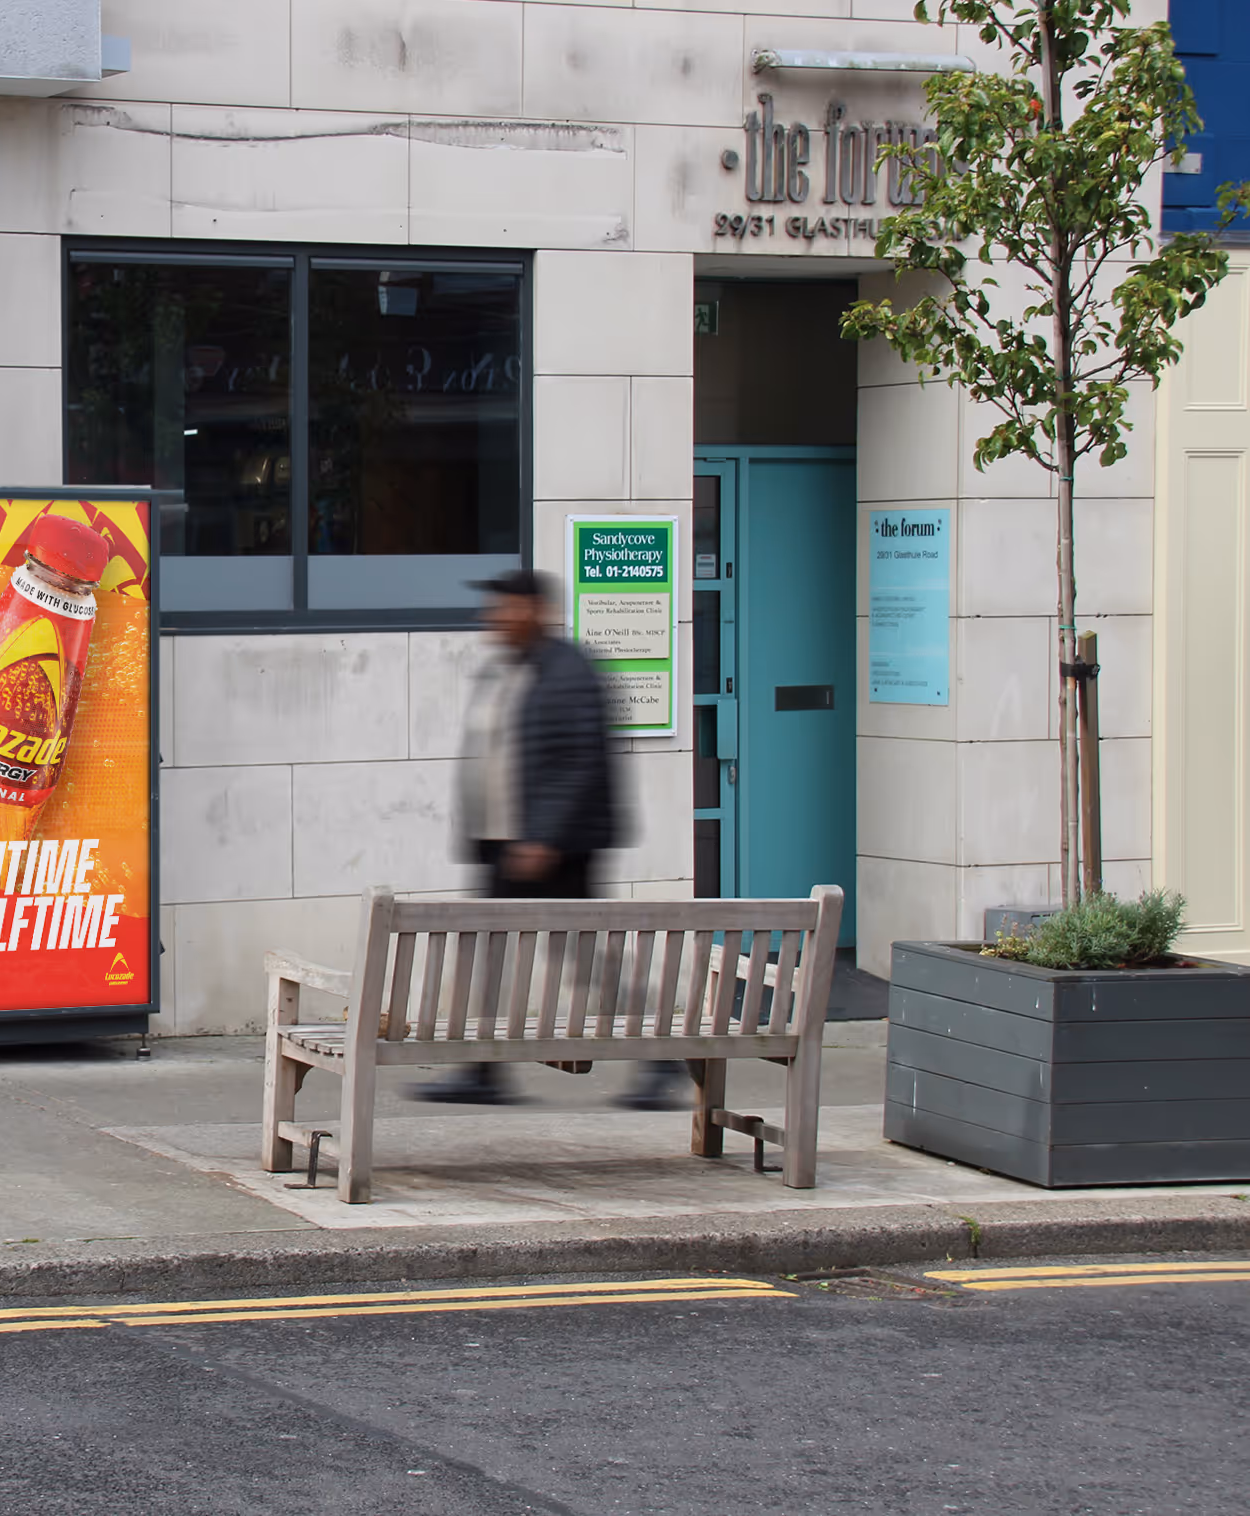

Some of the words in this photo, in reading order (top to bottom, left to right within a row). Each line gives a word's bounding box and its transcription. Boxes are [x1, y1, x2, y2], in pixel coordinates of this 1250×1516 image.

[743, 93, 811, 203] the
[713, 212, 776, 240] 29/31
[785, 214, 887, 241] GLASTHU
[881, 517, 898, 537] the
[901, 517, 935, 537] forum
[592, 532, 655, 548] Sandycove
[584, 547, 663, 563] Physiotherapy
[922, 550, 938, 559] Road
[584, 566, 602, 578] Tel.
[606, 566, 664, 577] 01-2140575
[15, 576, 35, 596] MADE
[36, 589, 61, 608] WITH
[604, 629, 630, 637] O'Neill
[629, 696, 660, 705] McCabe
